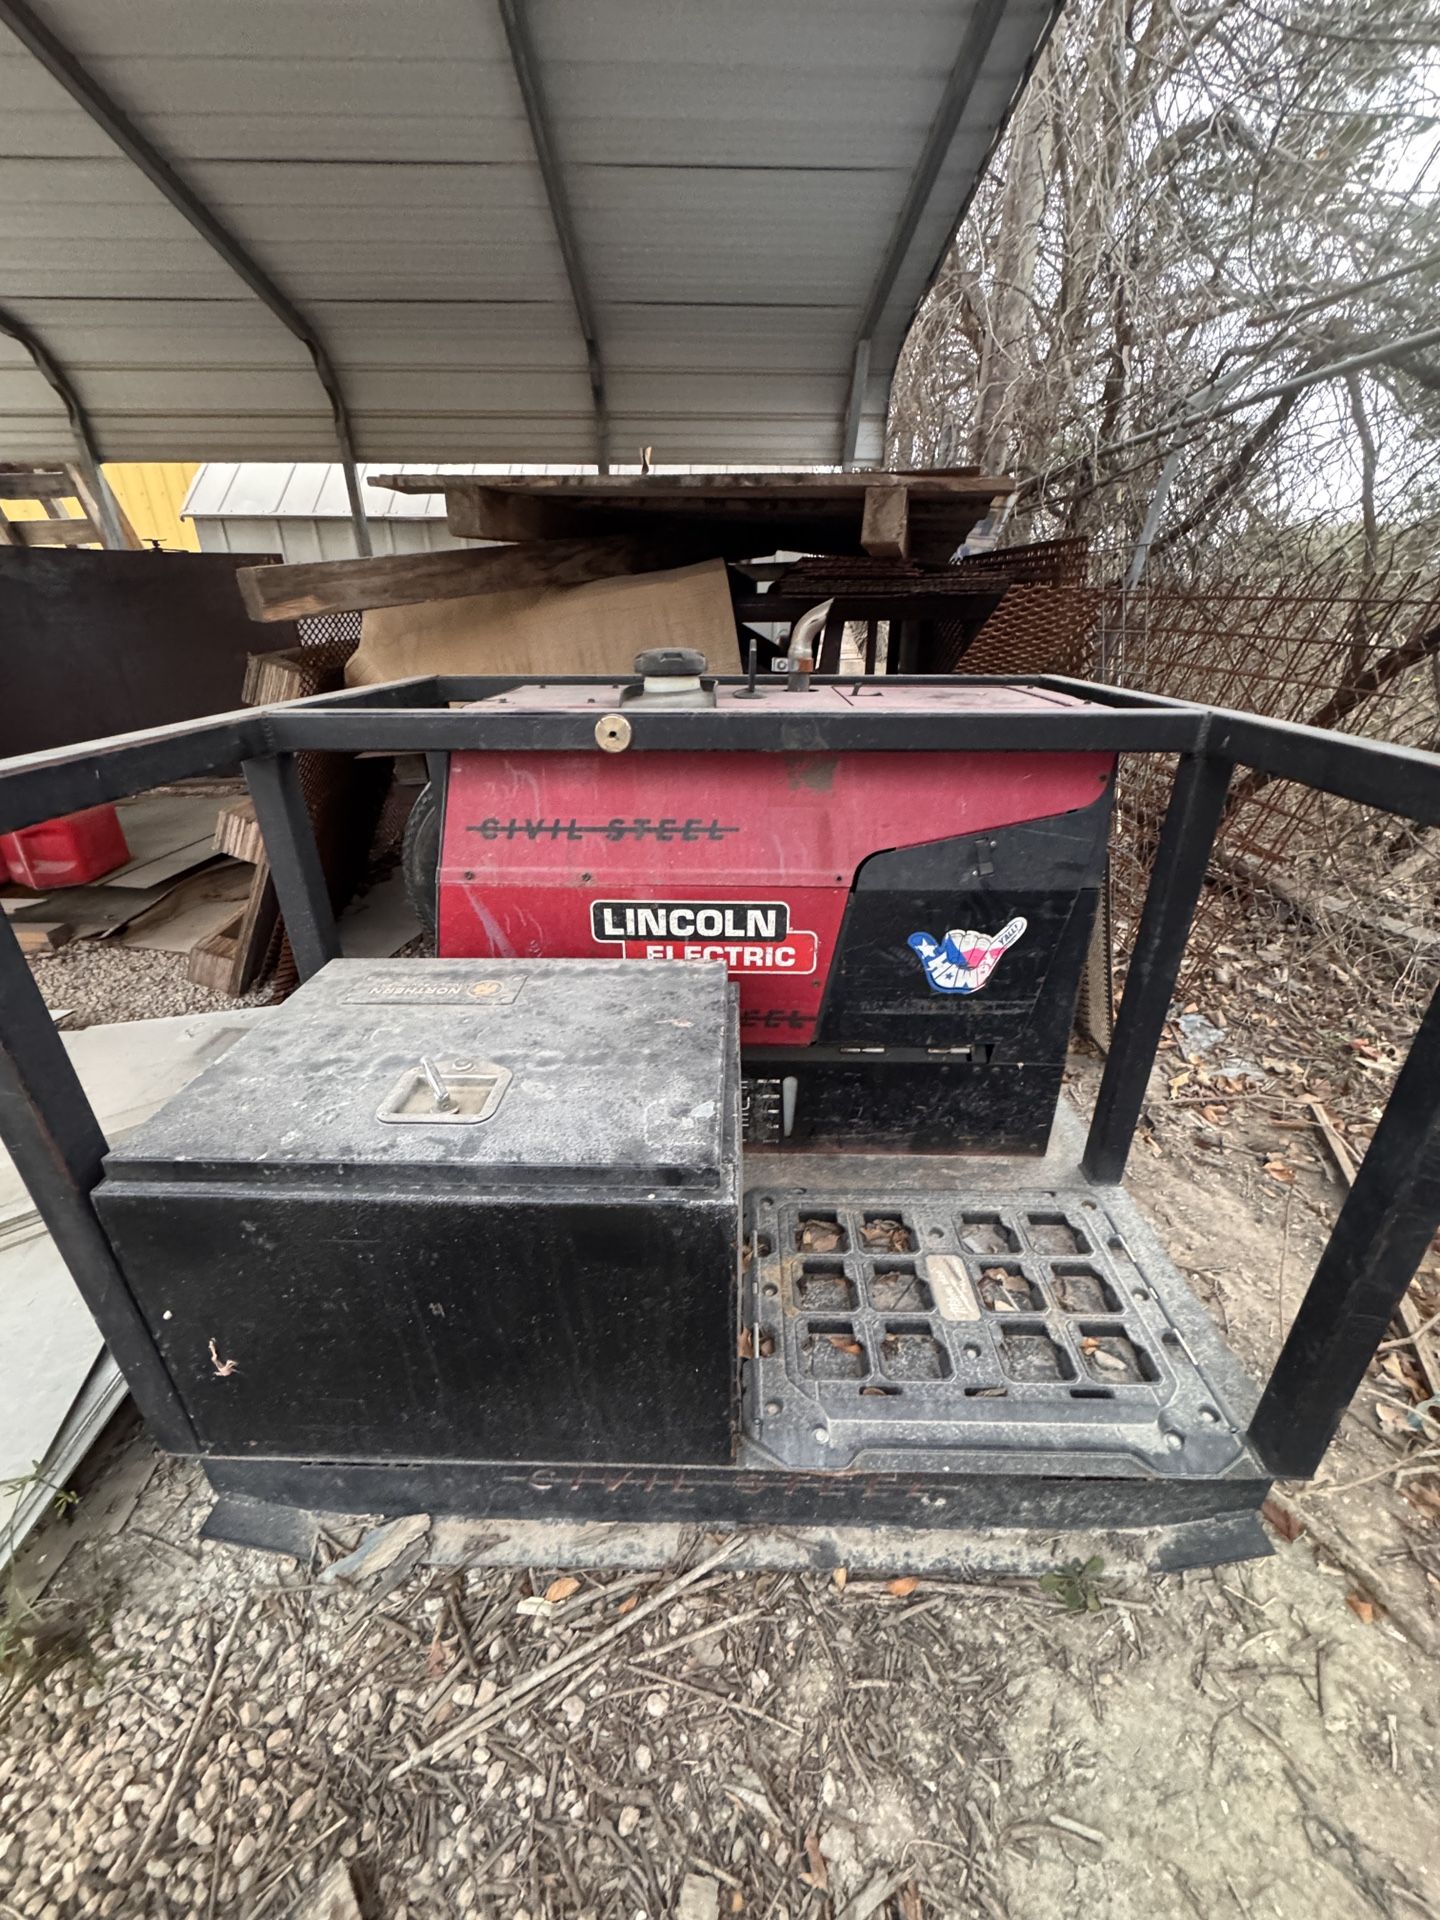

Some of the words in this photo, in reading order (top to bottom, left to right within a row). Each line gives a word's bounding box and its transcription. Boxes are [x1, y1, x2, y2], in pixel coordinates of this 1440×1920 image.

[480, 818, 583, 841] CIVIL
[605, 818, 725, 842] STEEL
[603, 908, 776, 937] LINCOLN
[646, 945, 796, 967] ELECTRIC
[368, 986, 462, 995] NORTHERN
[740, 1008, 805, 1029] EEL
[529, 1468, 696, 1493] CIVIL
